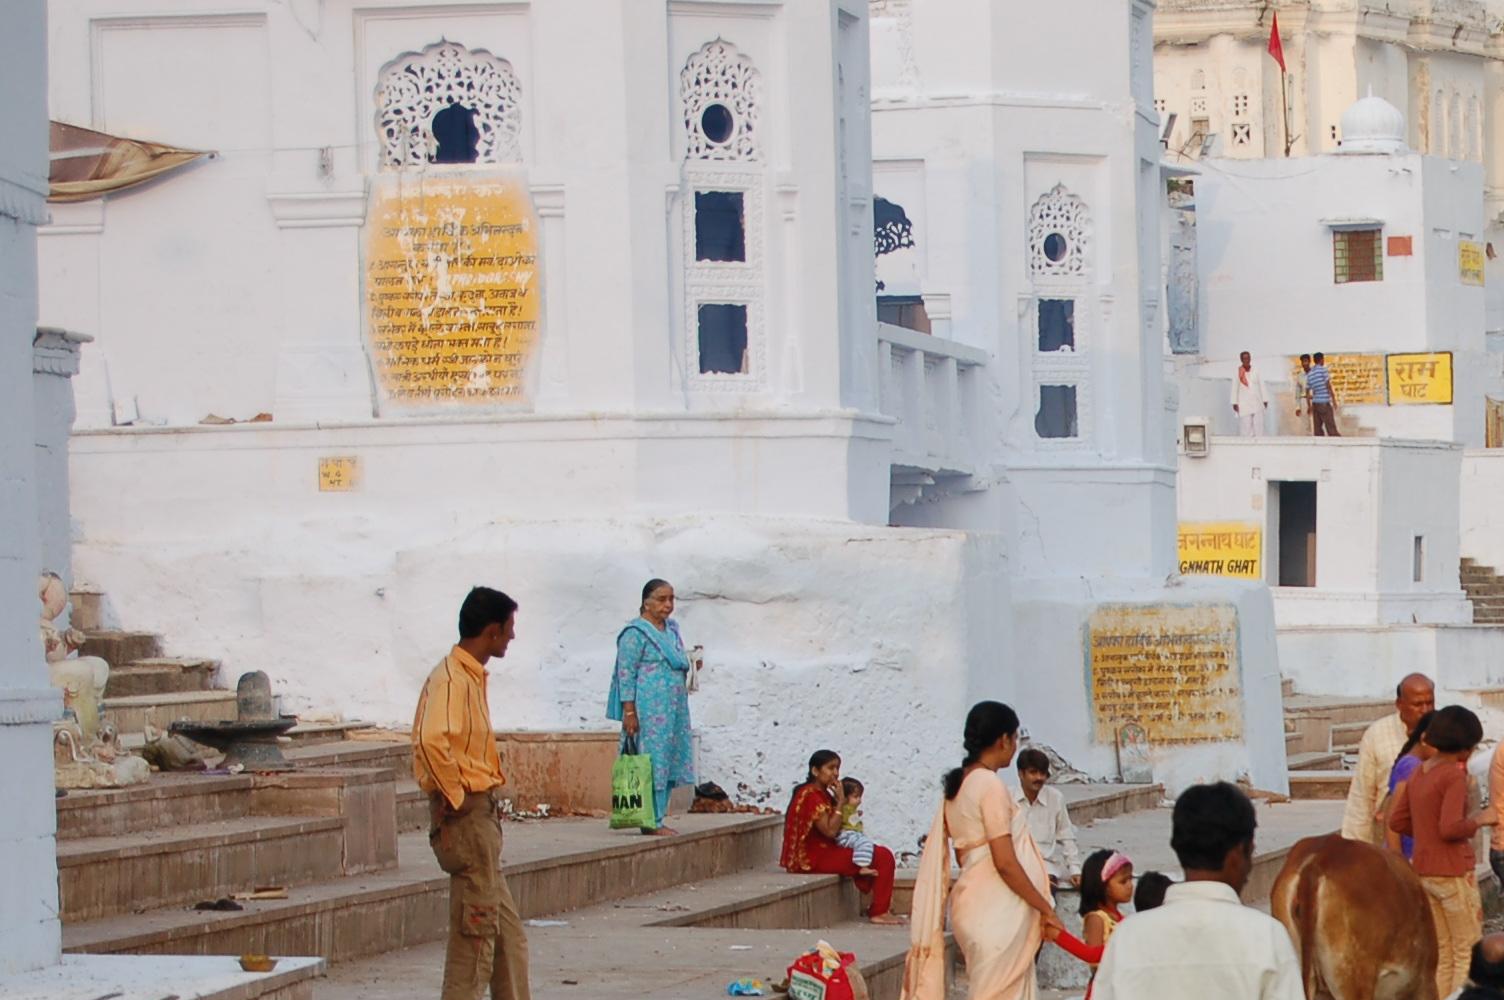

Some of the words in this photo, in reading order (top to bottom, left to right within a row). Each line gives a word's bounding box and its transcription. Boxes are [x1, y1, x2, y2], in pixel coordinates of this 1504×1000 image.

[1395, 360, 1440, 382] राम
[1399, 383, 1429, 398] घाट
[1178, 533, 1233, 550] जगन्नाथ
[1234, 531, 1258, 549] घाट
[1179, 559, 1225, 575] GNNATH
[1227, 559, 1257, 574] GHAT
